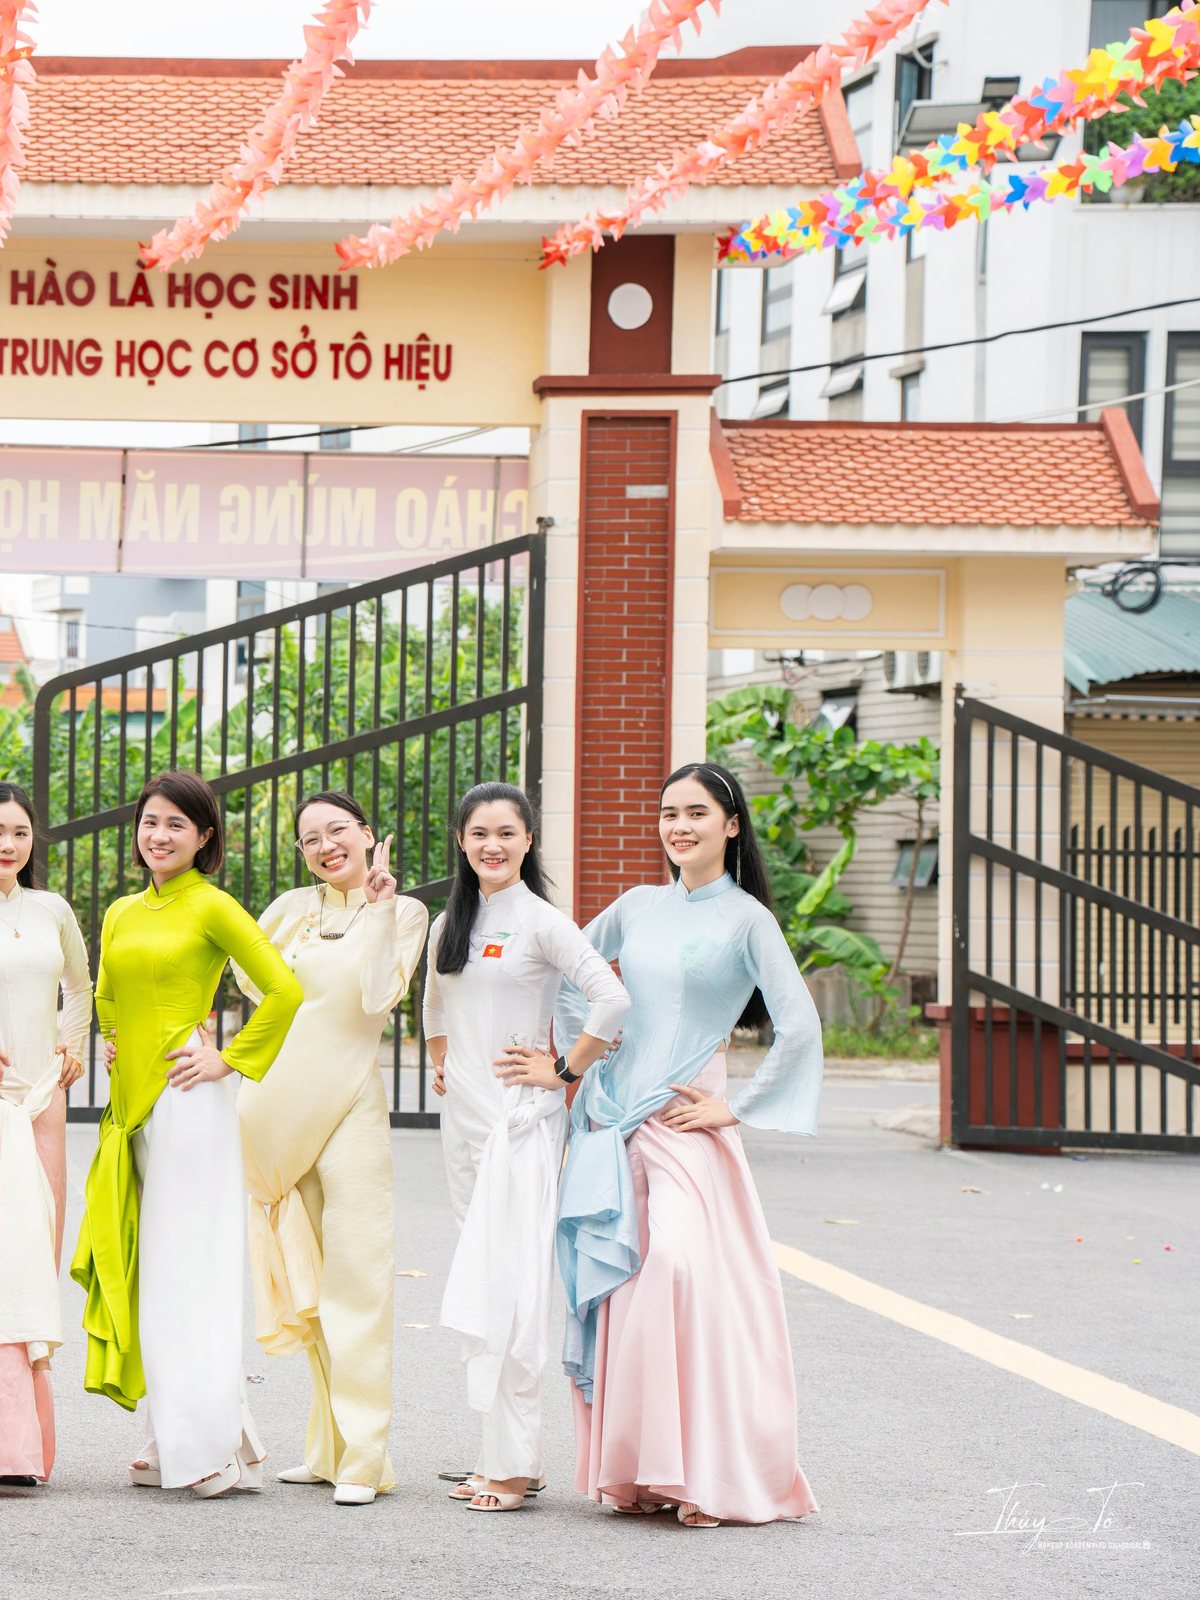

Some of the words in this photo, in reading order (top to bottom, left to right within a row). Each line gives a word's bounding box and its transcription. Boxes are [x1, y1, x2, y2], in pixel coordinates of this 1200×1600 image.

[10, 258, 95, 307] HÀO
[109, 259, 154, 308] LÀ
[168, 272, 256, 319] HỌC
[268, 273, 358, 310] SINH
[115, 339, 192, 386] HỌC
[204, 338, 259, 378] CƠ
[271, 325, 318, 379] SỞ
[329, 331, 372, 380] TÔ
[384, 333, 452, 390] HIỆU
